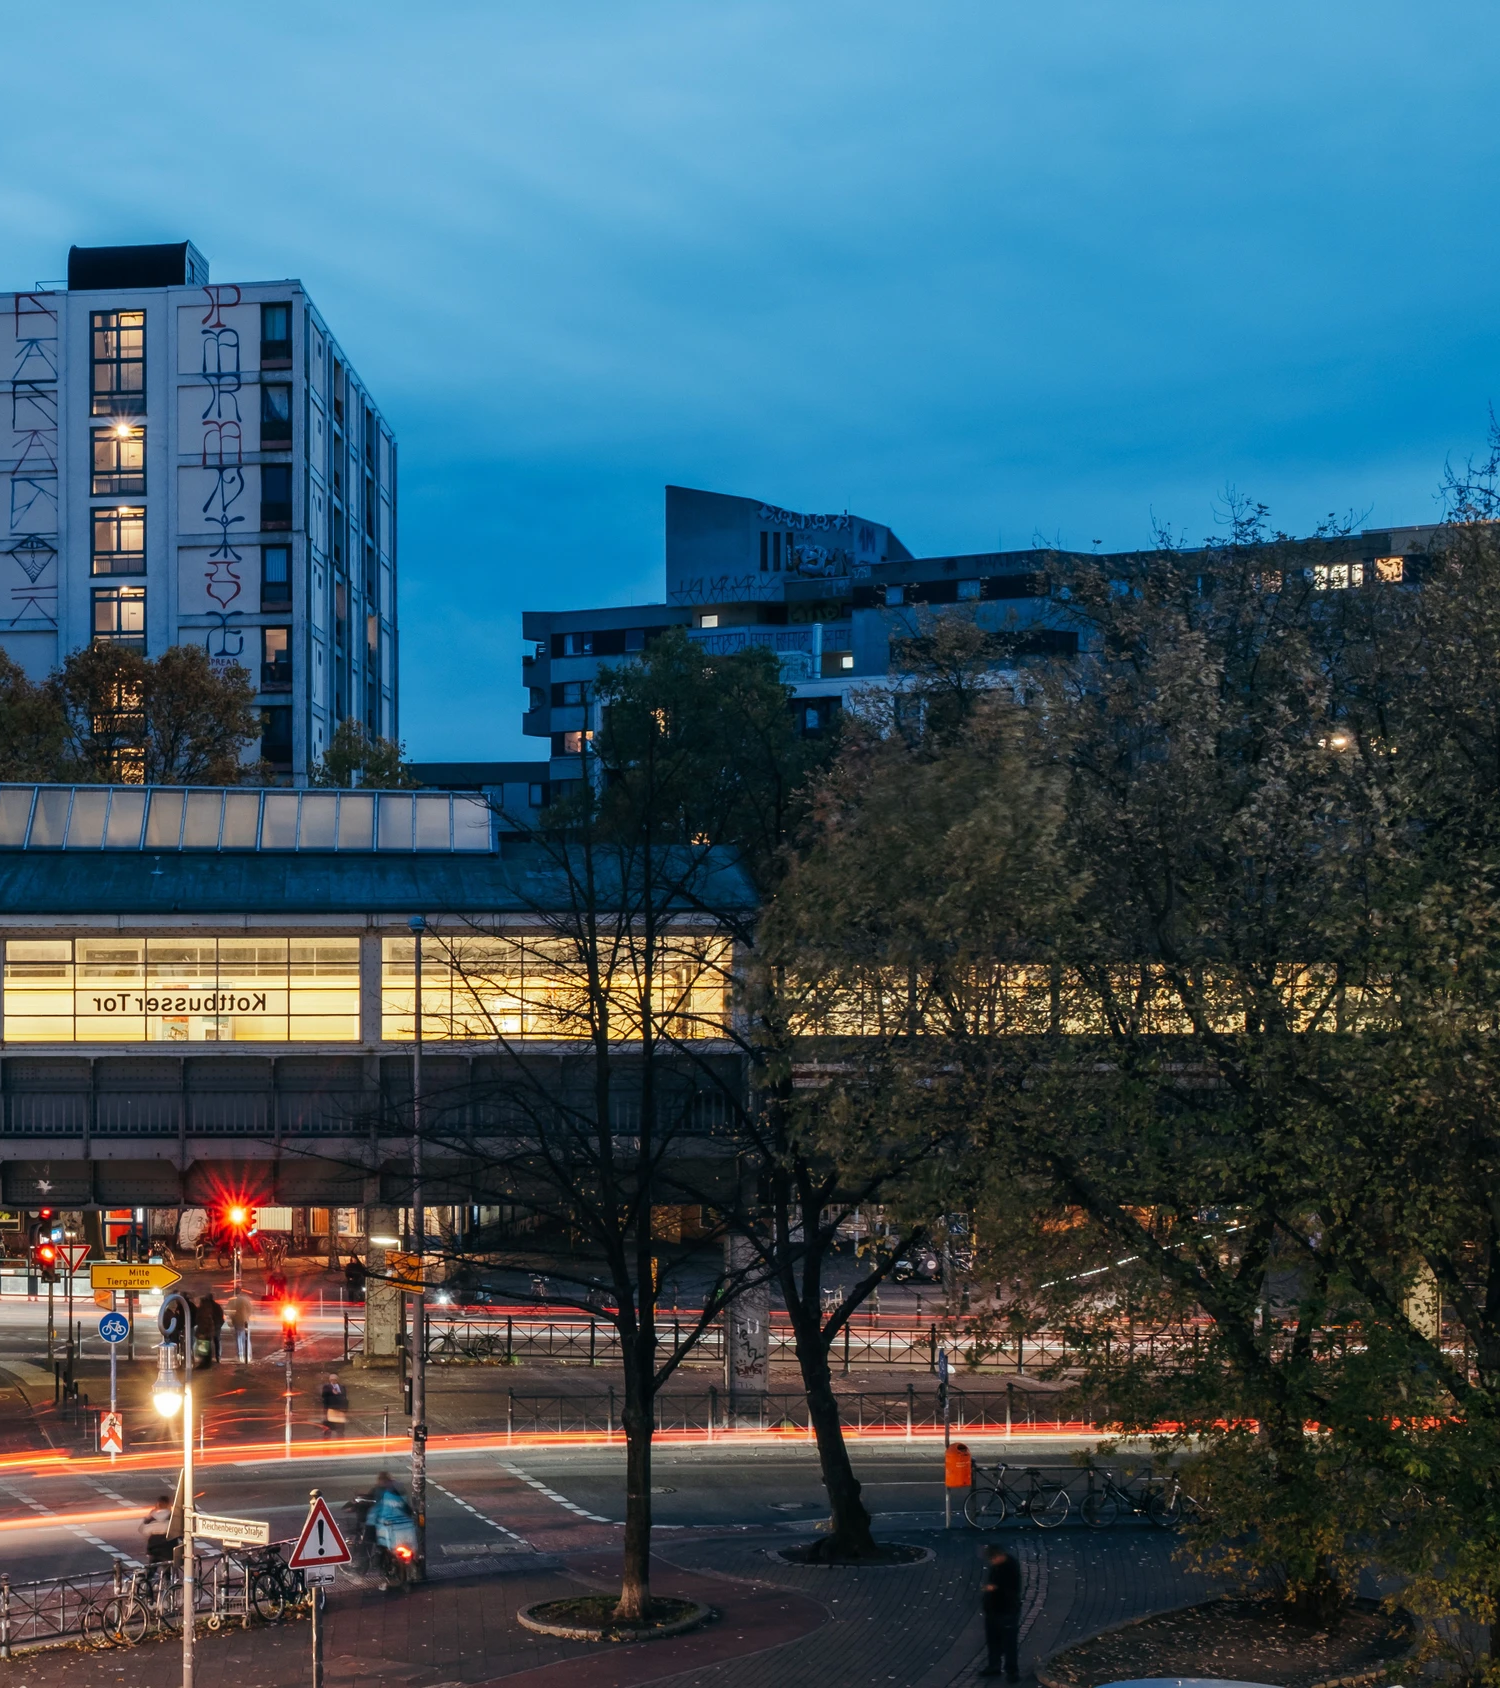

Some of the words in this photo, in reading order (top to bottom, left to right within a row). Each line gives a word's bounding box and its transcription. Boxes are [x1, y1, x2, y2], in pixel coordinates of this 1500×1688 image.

[129, 1269, 150, 1277] Mitte
[106, 1278, 150, 1287] Tiergarten
[201, 1519, 243, 1536] Reichenberger
[244, 1524, 264, 1538] Straße
